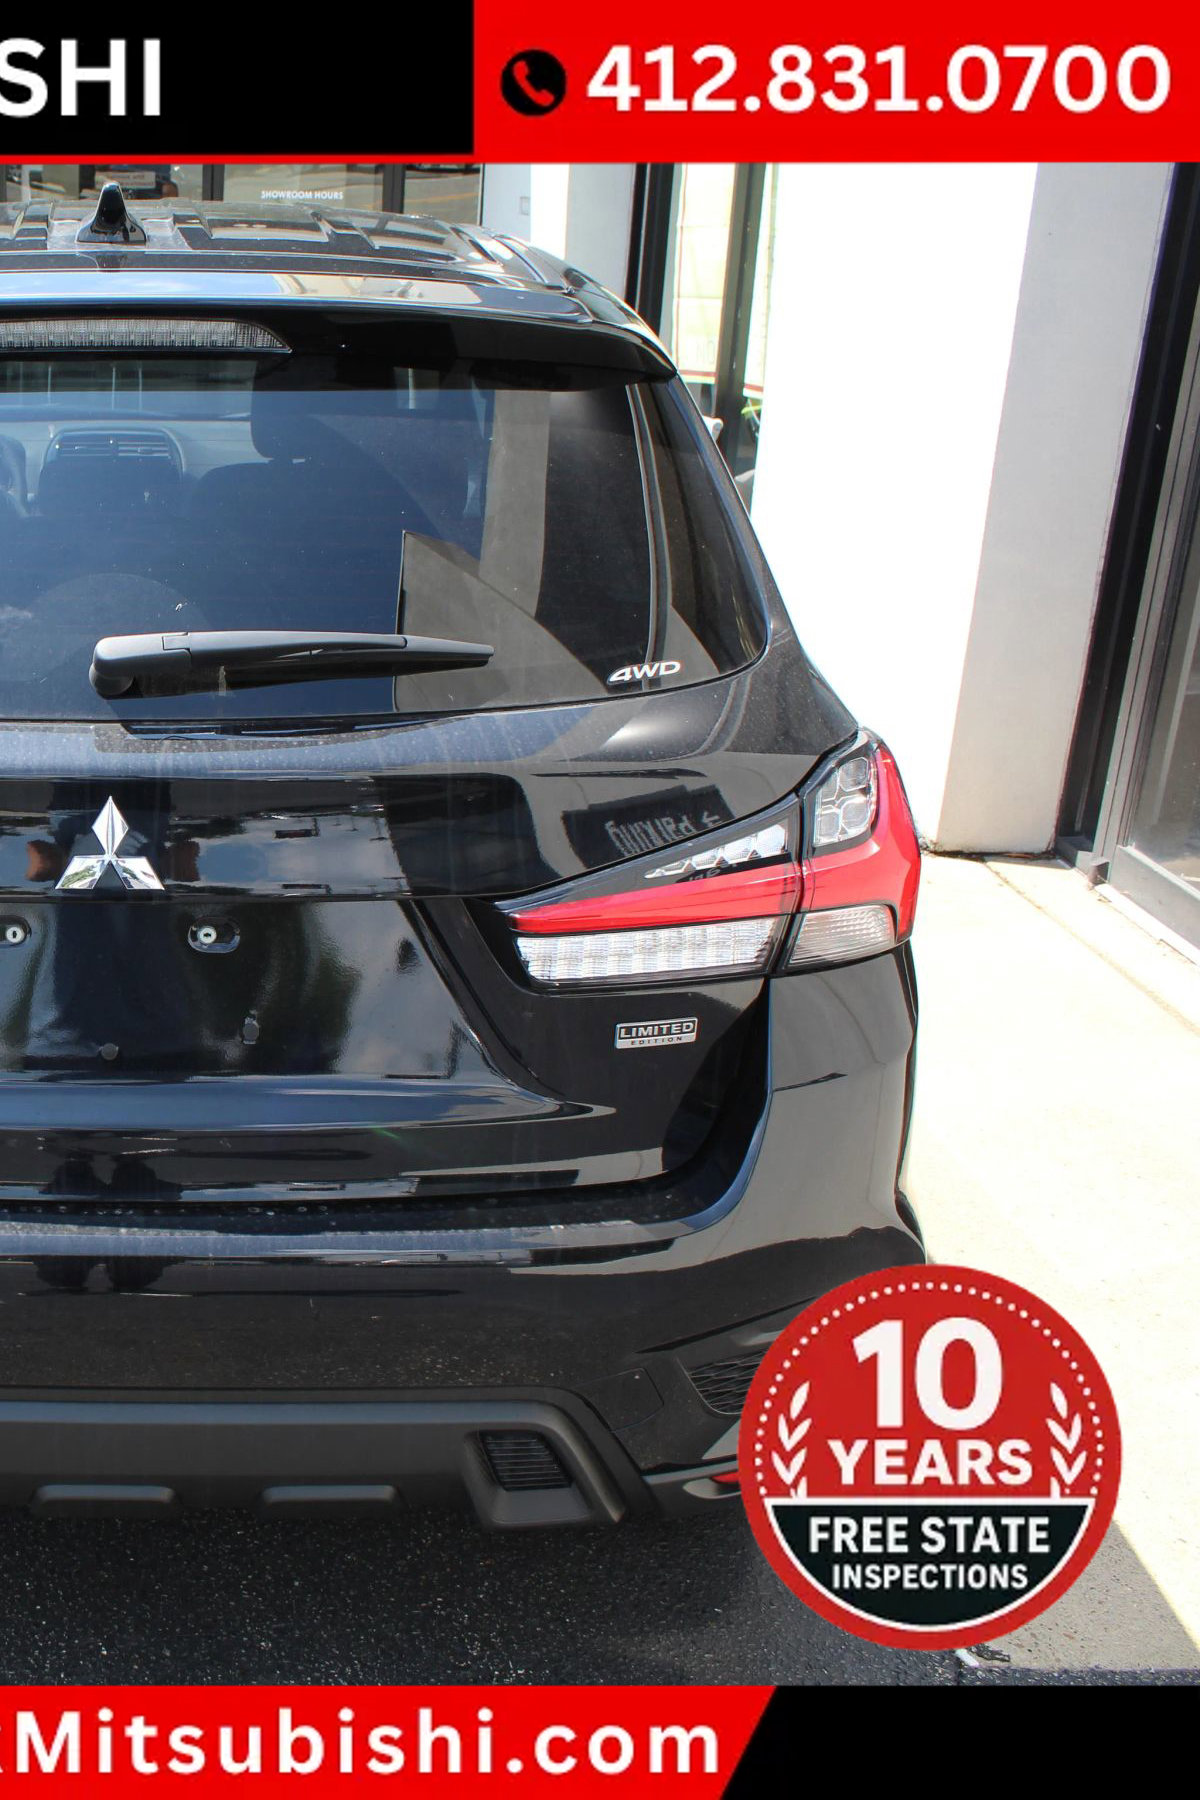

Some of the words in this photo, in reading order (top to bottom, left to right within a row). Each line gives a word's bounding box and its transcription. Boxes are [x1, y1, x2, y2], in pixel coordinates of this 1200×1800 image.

[261, 190, 313, 200] SHOWROOM
[314, 191, 344, 200] HOURS
[608, 661, 681, 682] 4WD
[620, 1022, 694, 1038] LIMITED
[631, 1037, 682, 1046] EDITION
